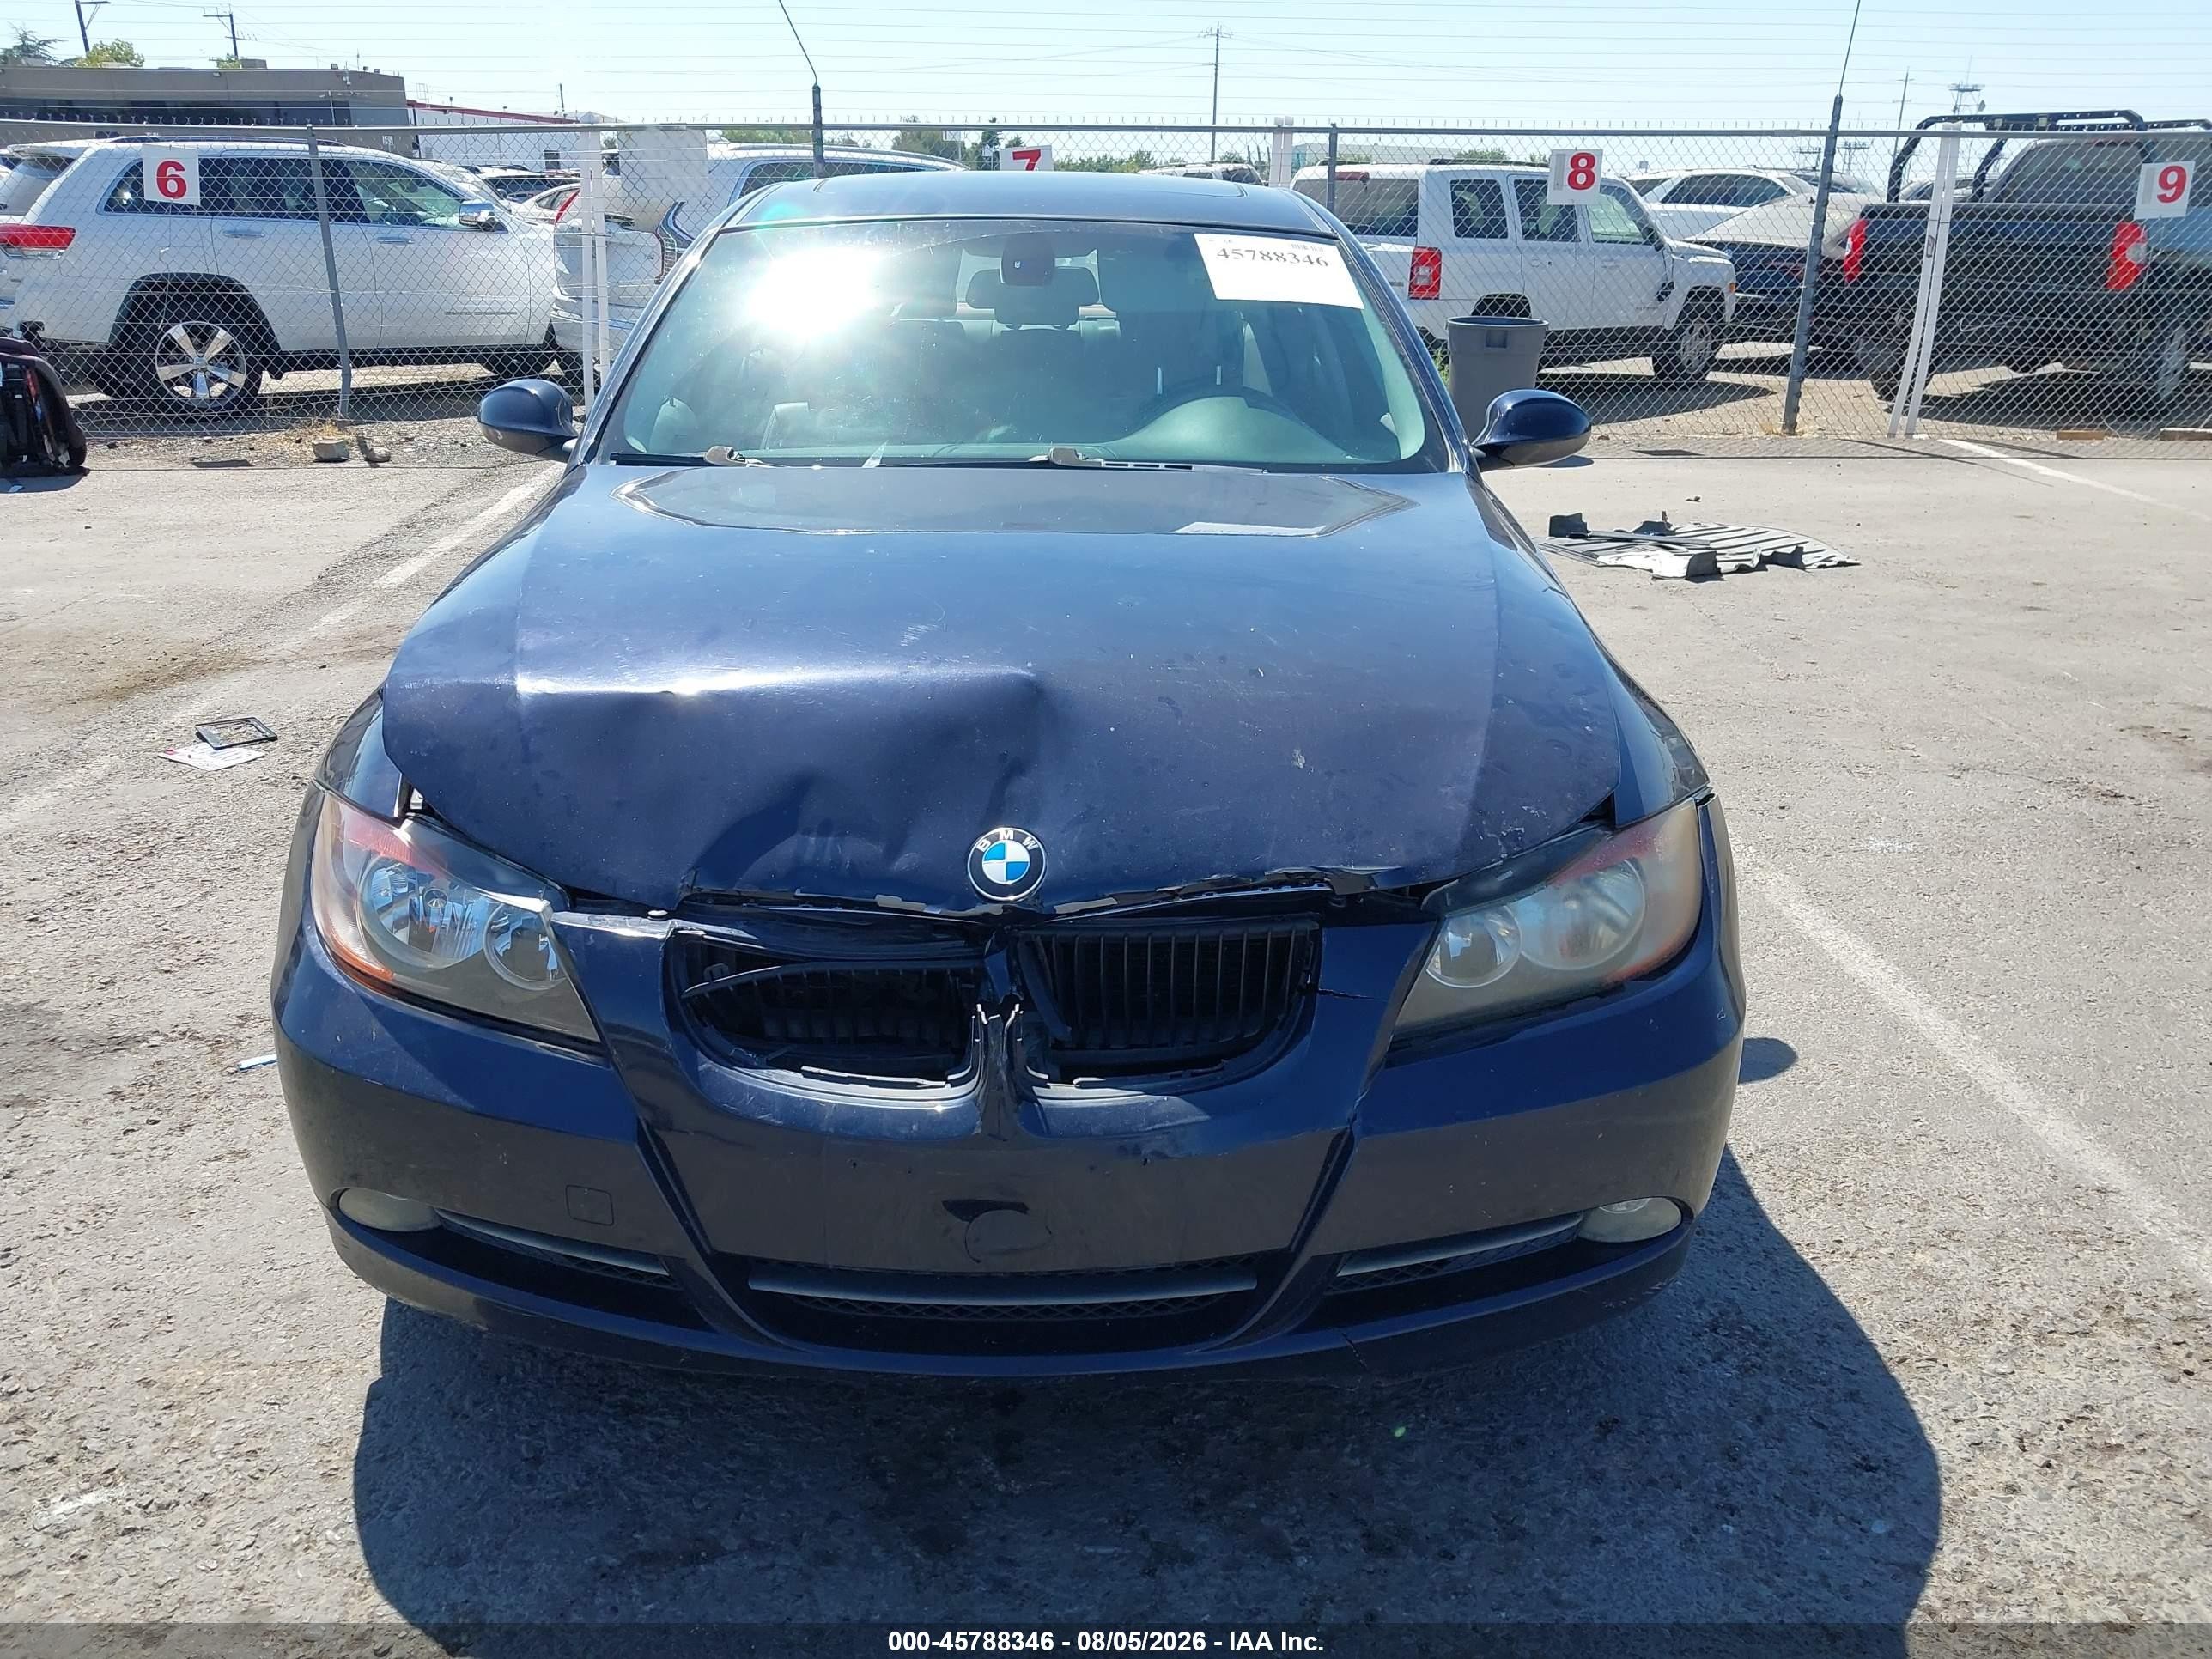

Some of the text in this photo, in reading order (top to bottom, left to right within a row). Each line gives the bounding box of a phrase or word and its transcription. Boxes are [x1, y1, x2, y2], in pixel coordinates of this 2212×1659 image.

[1012, 149, 1041, 171] 7
[1567, 152, 1596, 191] 8
[156, 160, 187, 199] 6
[2157, 165, 2187, 203] 9
[1217, 247, 1329, 267] 45788346
[975, 830, 1039, 852] BMW
